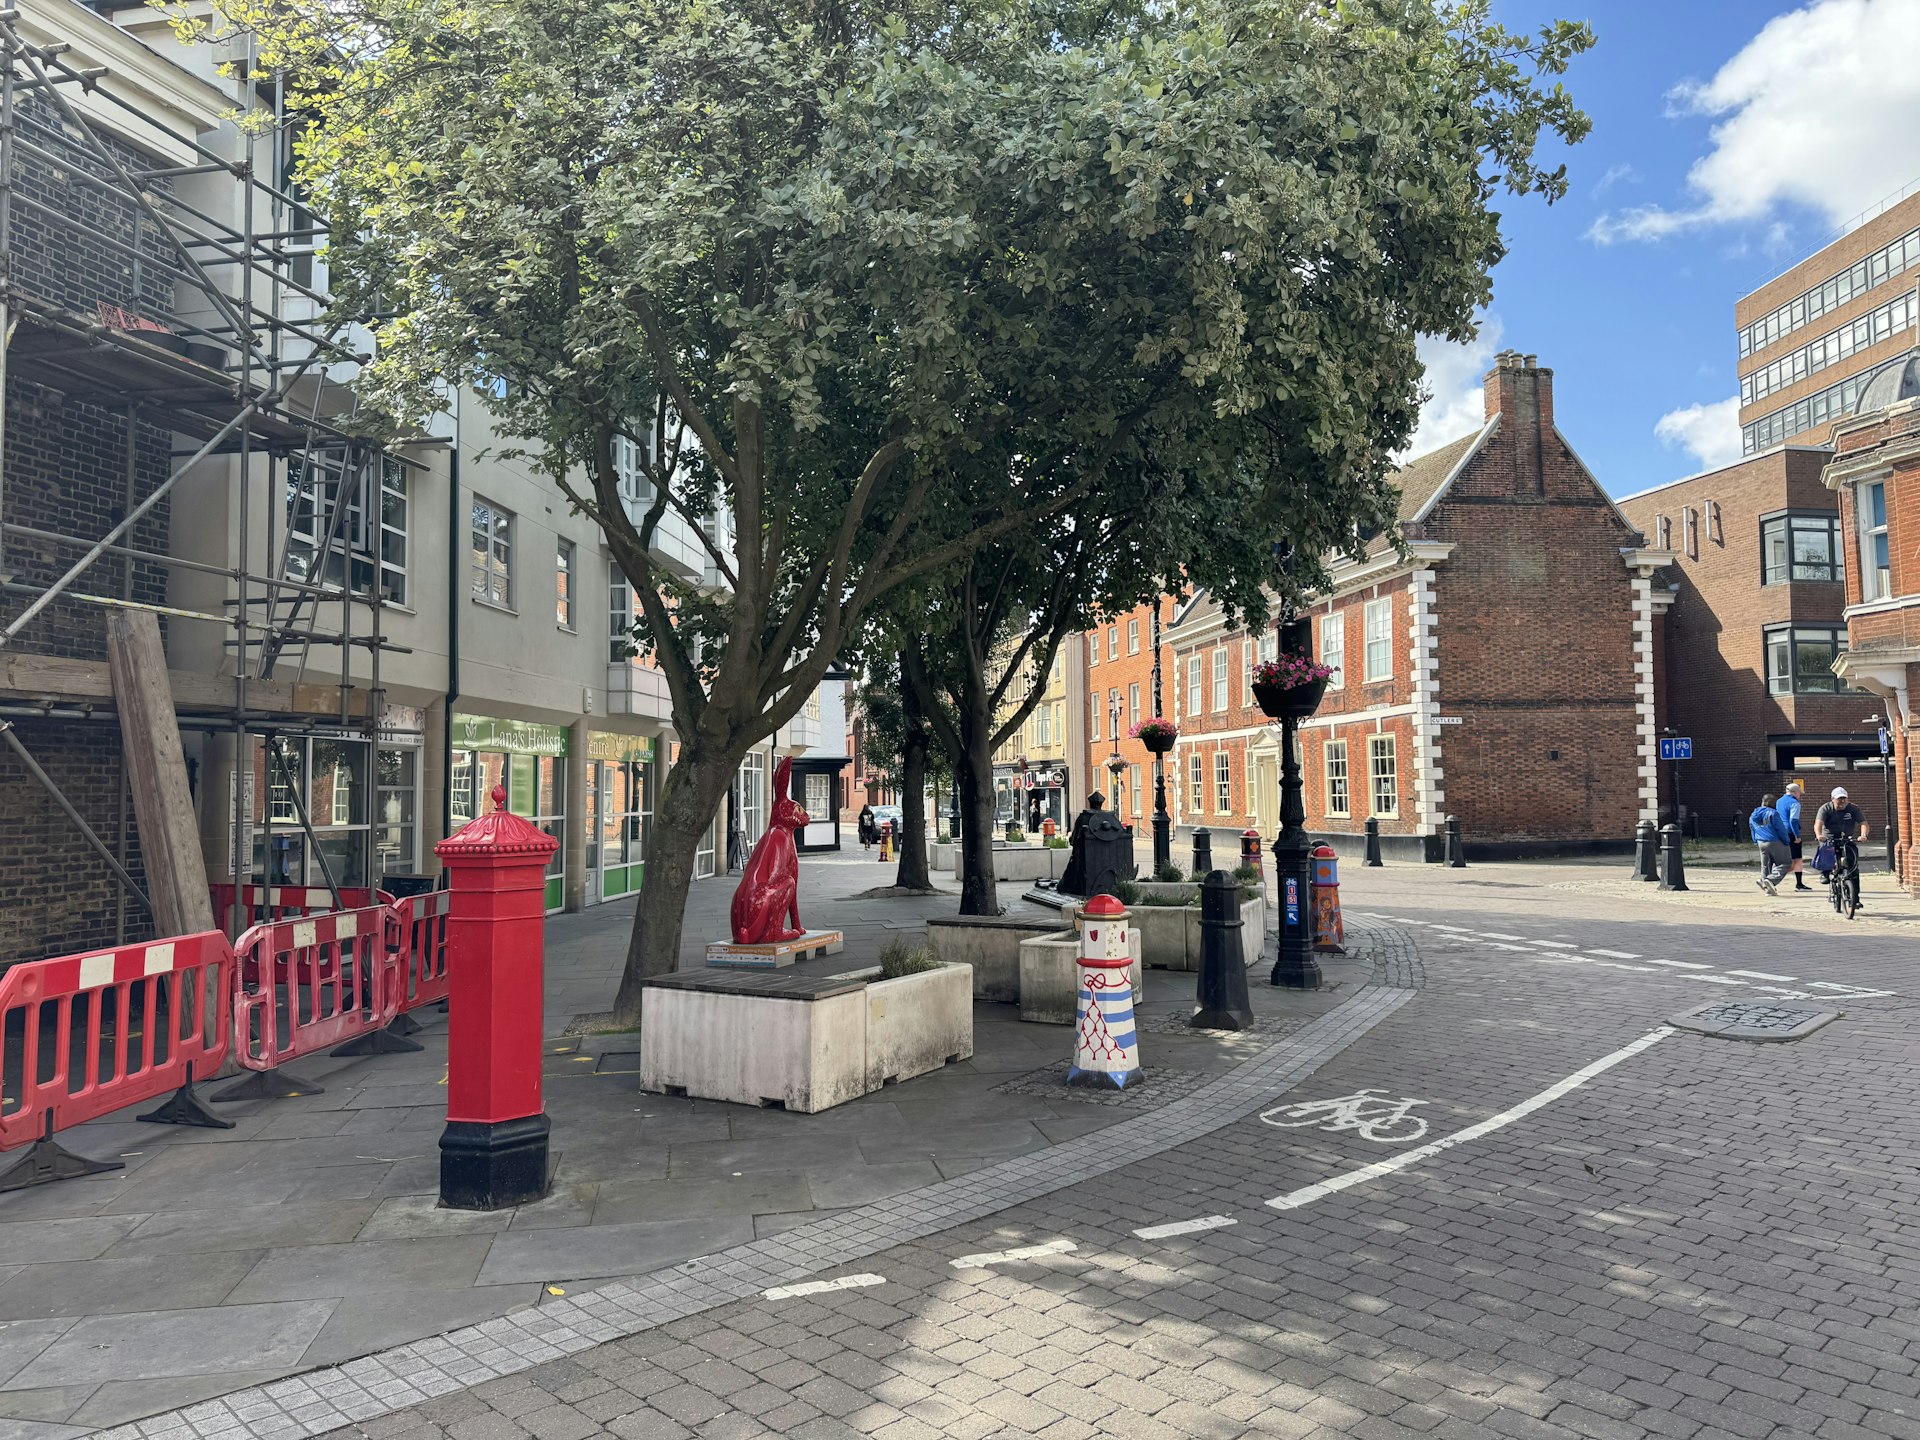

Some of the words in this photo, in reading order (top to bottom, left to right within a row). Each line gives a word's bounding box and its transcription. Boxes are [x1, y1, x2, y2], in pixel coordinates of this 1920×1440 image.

[490, 722, 525, 748] Lana's
[527, 727, 565, 752] Holistic
[588, 740, 609, 755] entre
